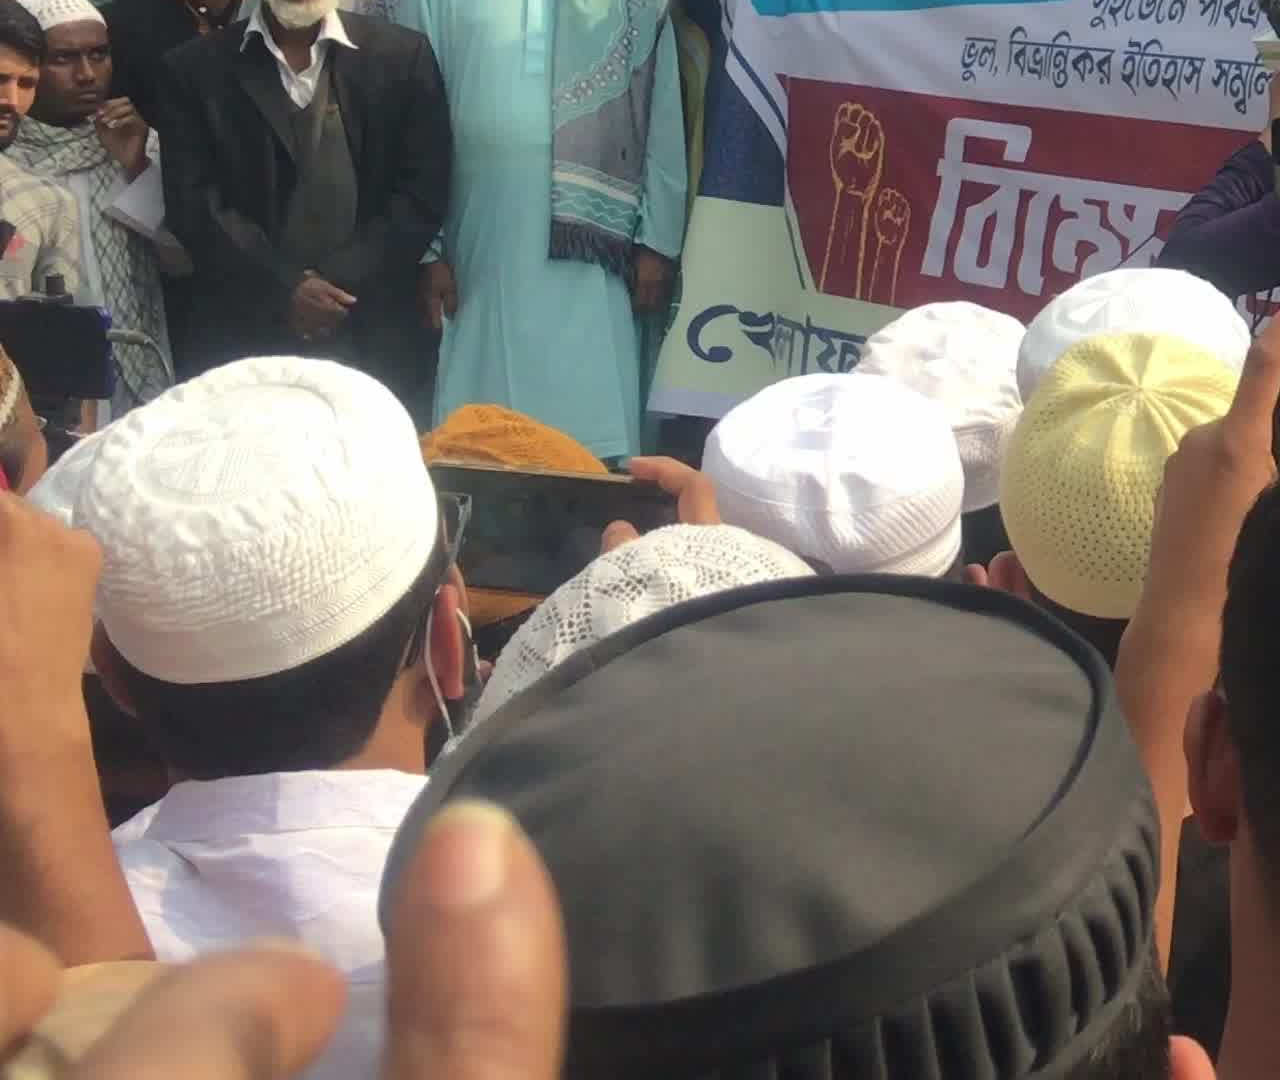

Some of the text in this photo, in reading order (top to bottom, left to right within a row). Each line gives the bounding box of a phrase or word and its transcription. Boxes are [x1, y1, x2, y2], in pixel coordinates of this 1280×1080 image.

[961, 36, 999, 83] ভুল,
[1008, 26, 1115, 88] বিভ্রান্তিকর
[1121, 38, 1206, 101] ইতিহাস
[1212, 54, 1273, 115] সম্বলি
